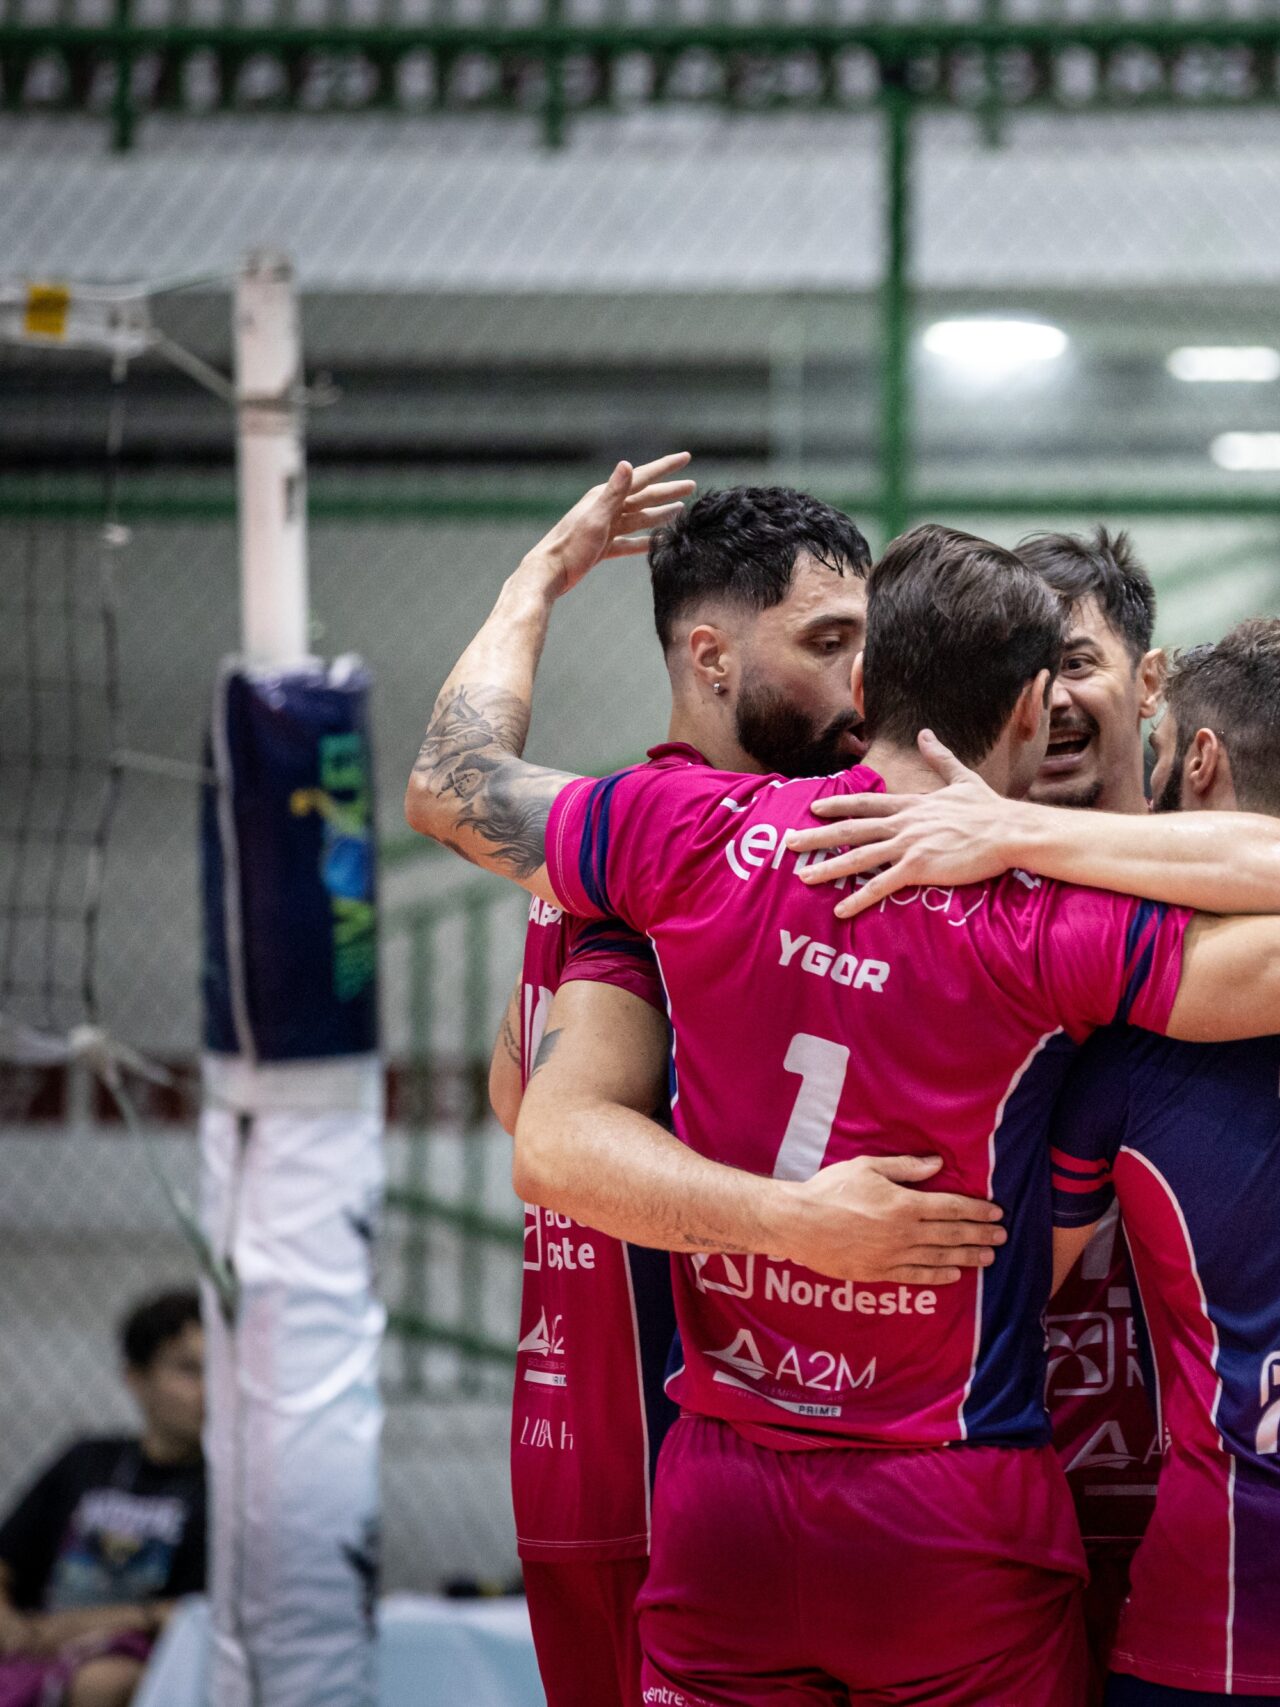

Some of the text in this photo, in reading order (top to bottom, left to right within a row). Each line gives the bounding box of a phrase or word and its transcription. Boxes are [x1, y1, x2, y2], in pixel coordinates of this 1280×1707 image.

[778, 929, 891, 993] YGOR
[772, 1032, 851, 1183] 1
[765, 1267, 937, 1315] Nordeste
[775, 1345, 877, 1391] A2M
[798, 1405, 838, 1416] PRIME
